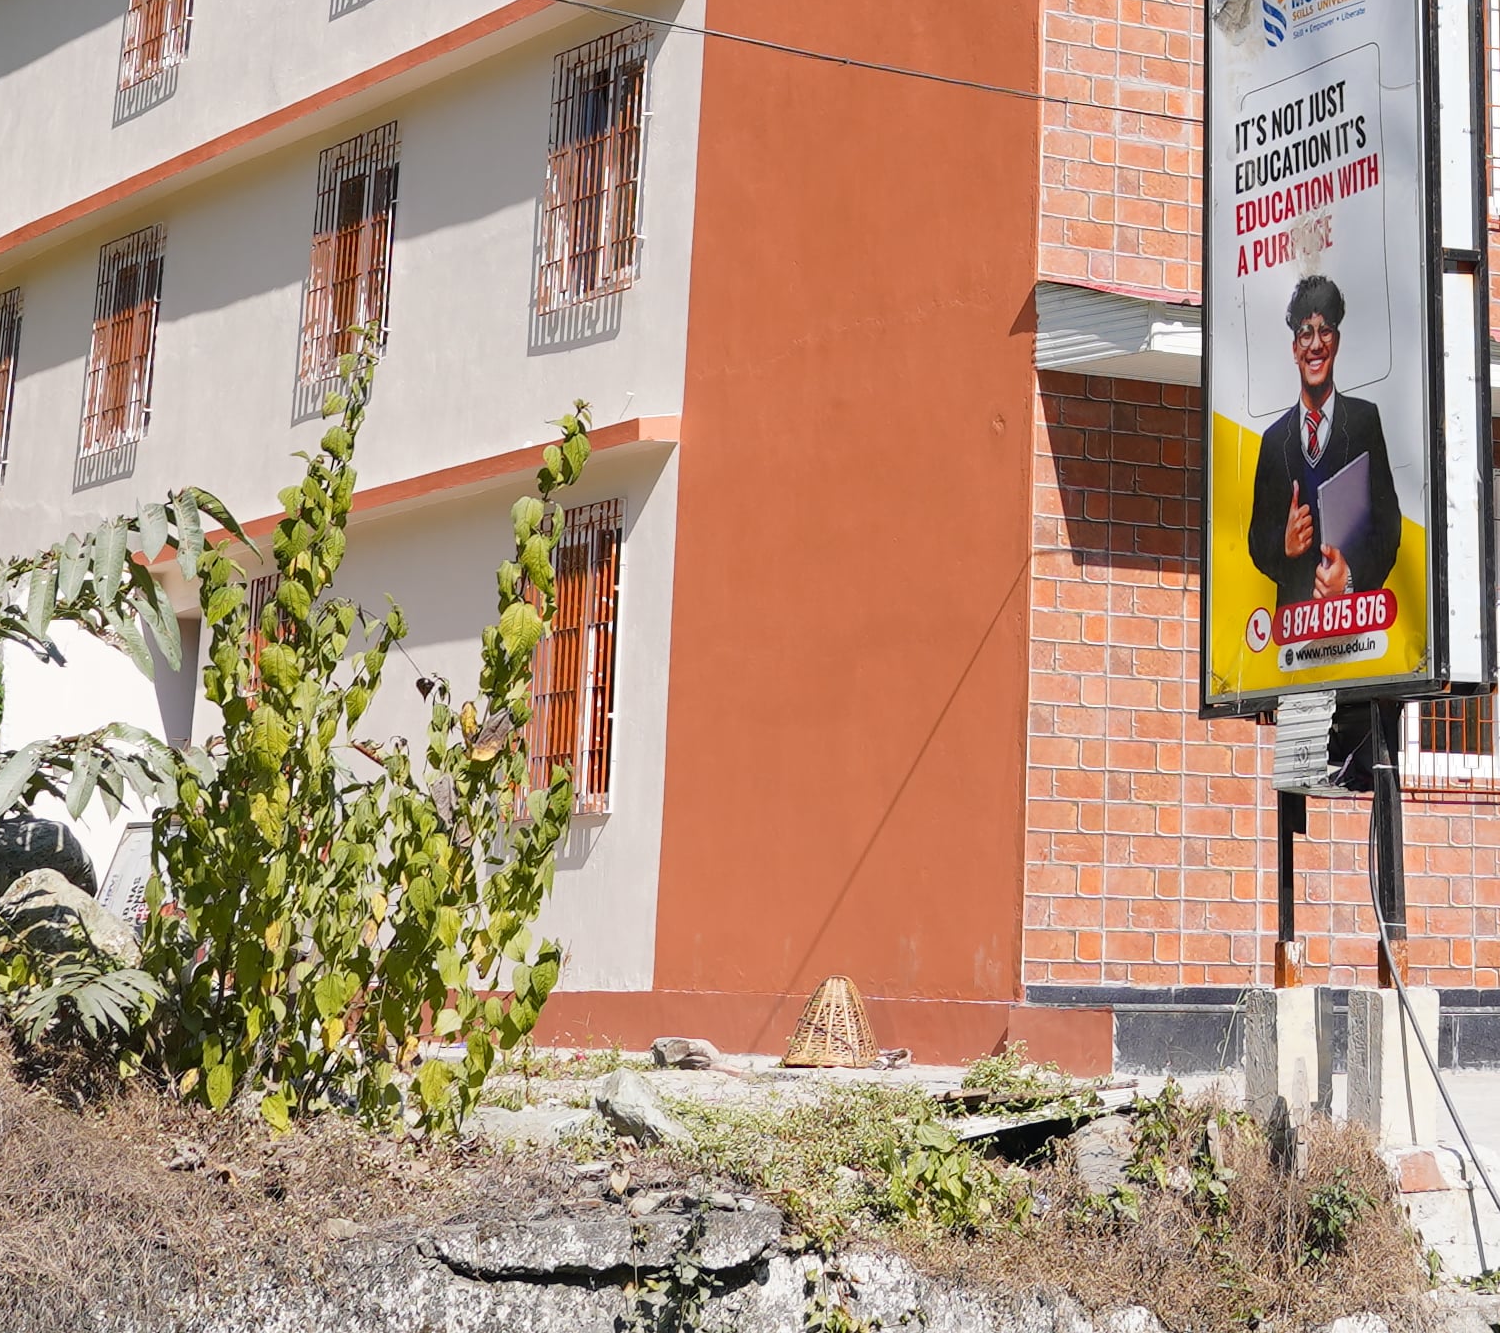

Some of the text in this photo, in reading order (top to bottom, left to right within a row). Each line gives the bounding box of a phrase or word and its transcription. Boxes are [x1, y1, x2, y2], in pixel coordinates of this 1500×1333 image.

[1292, 4, 1314, 21] SKILLS
[1309, 17, 1335, 33] Empower
[1235, 80, 1345, 154] IT'S NOT JUST
[1235, 115, 1367, 195] EDUCATION IT'S
[1236, 152, 1379, 236] EDUCATION WITH
[1237, 244, 1249, 278] A
[1282, 593, 1386, 639] 9 874 875 876
[1296, 637, 1376, 661] www.msu.edu.in
